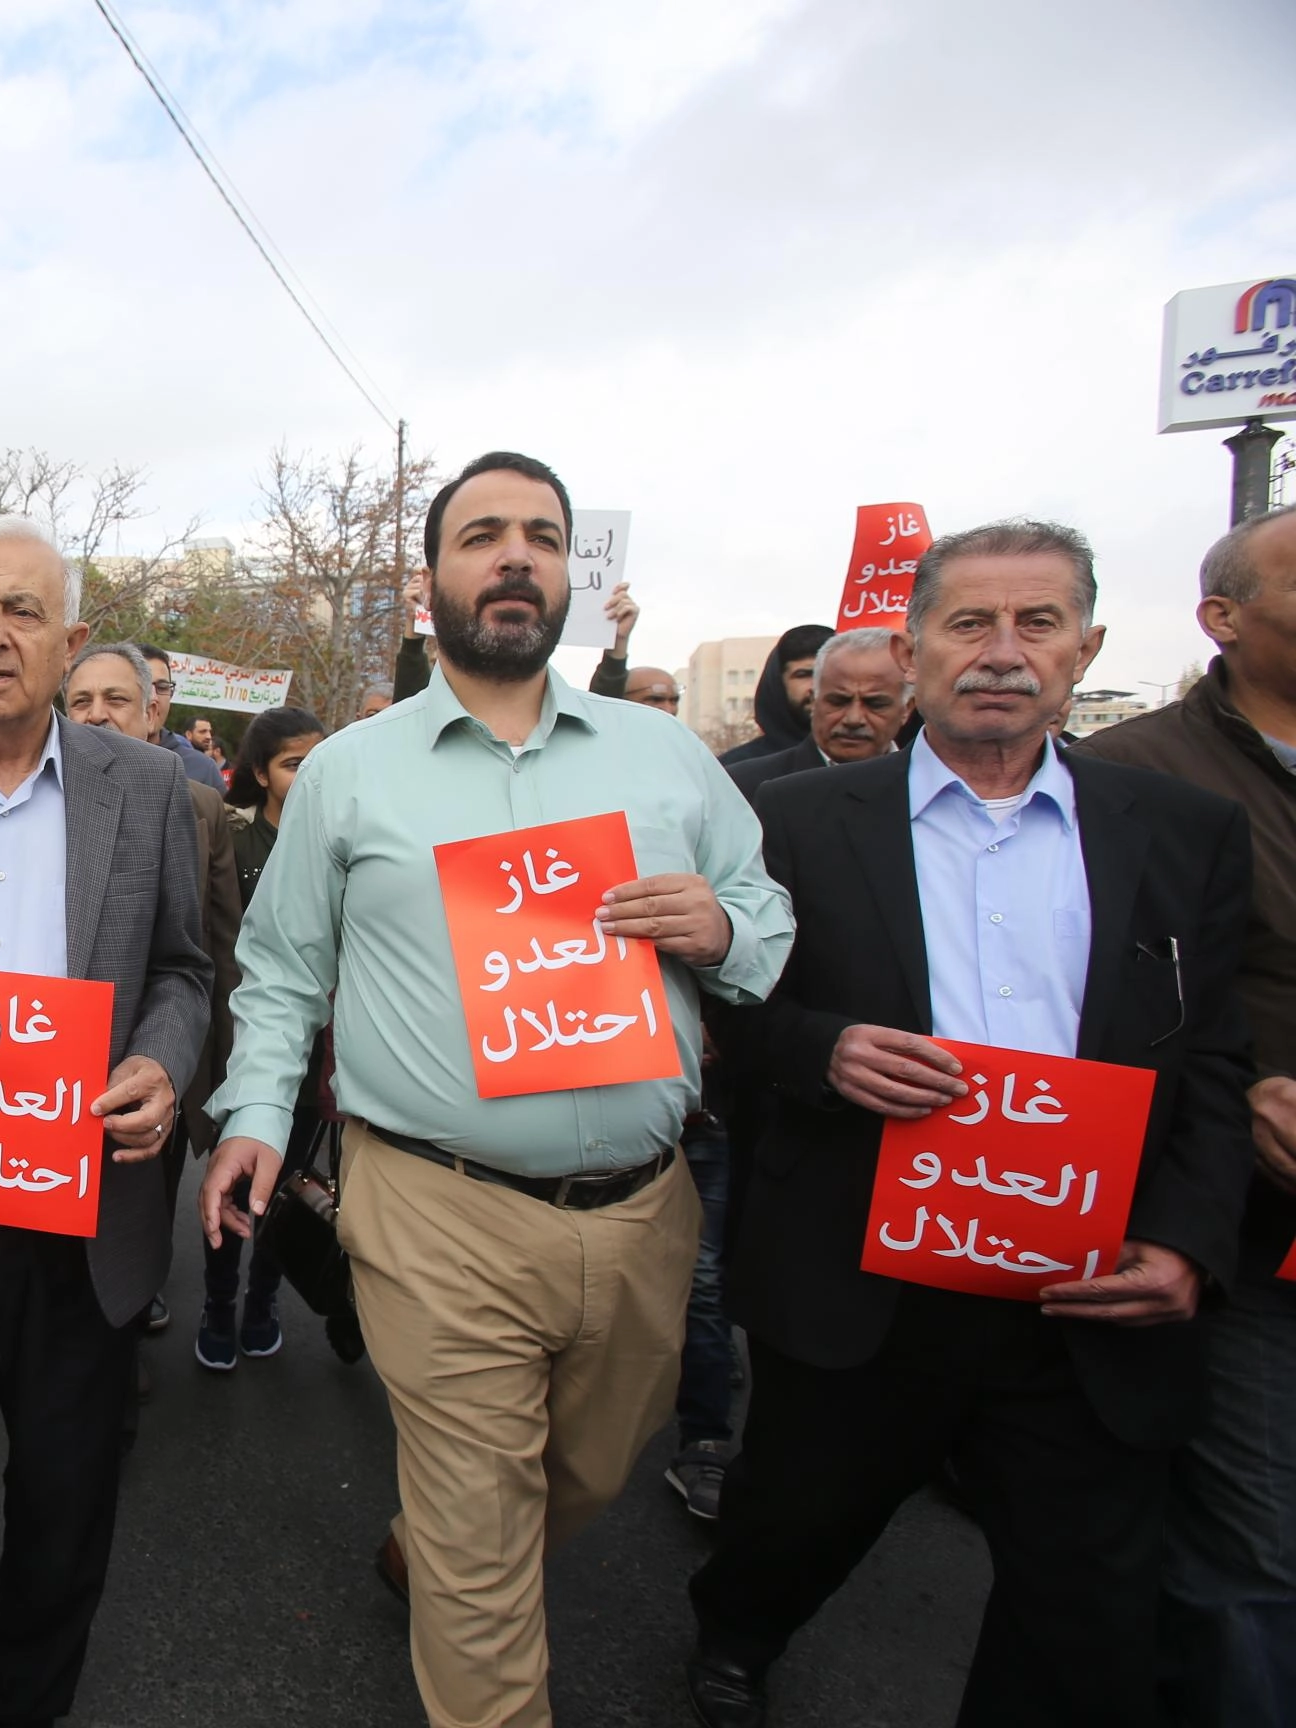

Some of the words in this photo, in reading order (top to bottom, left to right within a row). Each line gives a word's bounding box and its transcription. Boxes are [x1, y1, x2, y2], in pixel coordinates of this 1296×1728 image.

[1180, 331, 1296, 369] رفور
[1180, 358, 1296, 396] Carref
[878, 512, 921, 546] غاز
[853, 557, 919, 585] عدو
[842, 588, 911, 618] تلال
[494, 847, 581, 915] غاز
[481, 987, 658, 1064] احتلال
[947, 1072, 1070, 1126] غاز
[897, 1151, 1099, 1216] العدو
[877, 1204, 1100, 1281] احتلال
